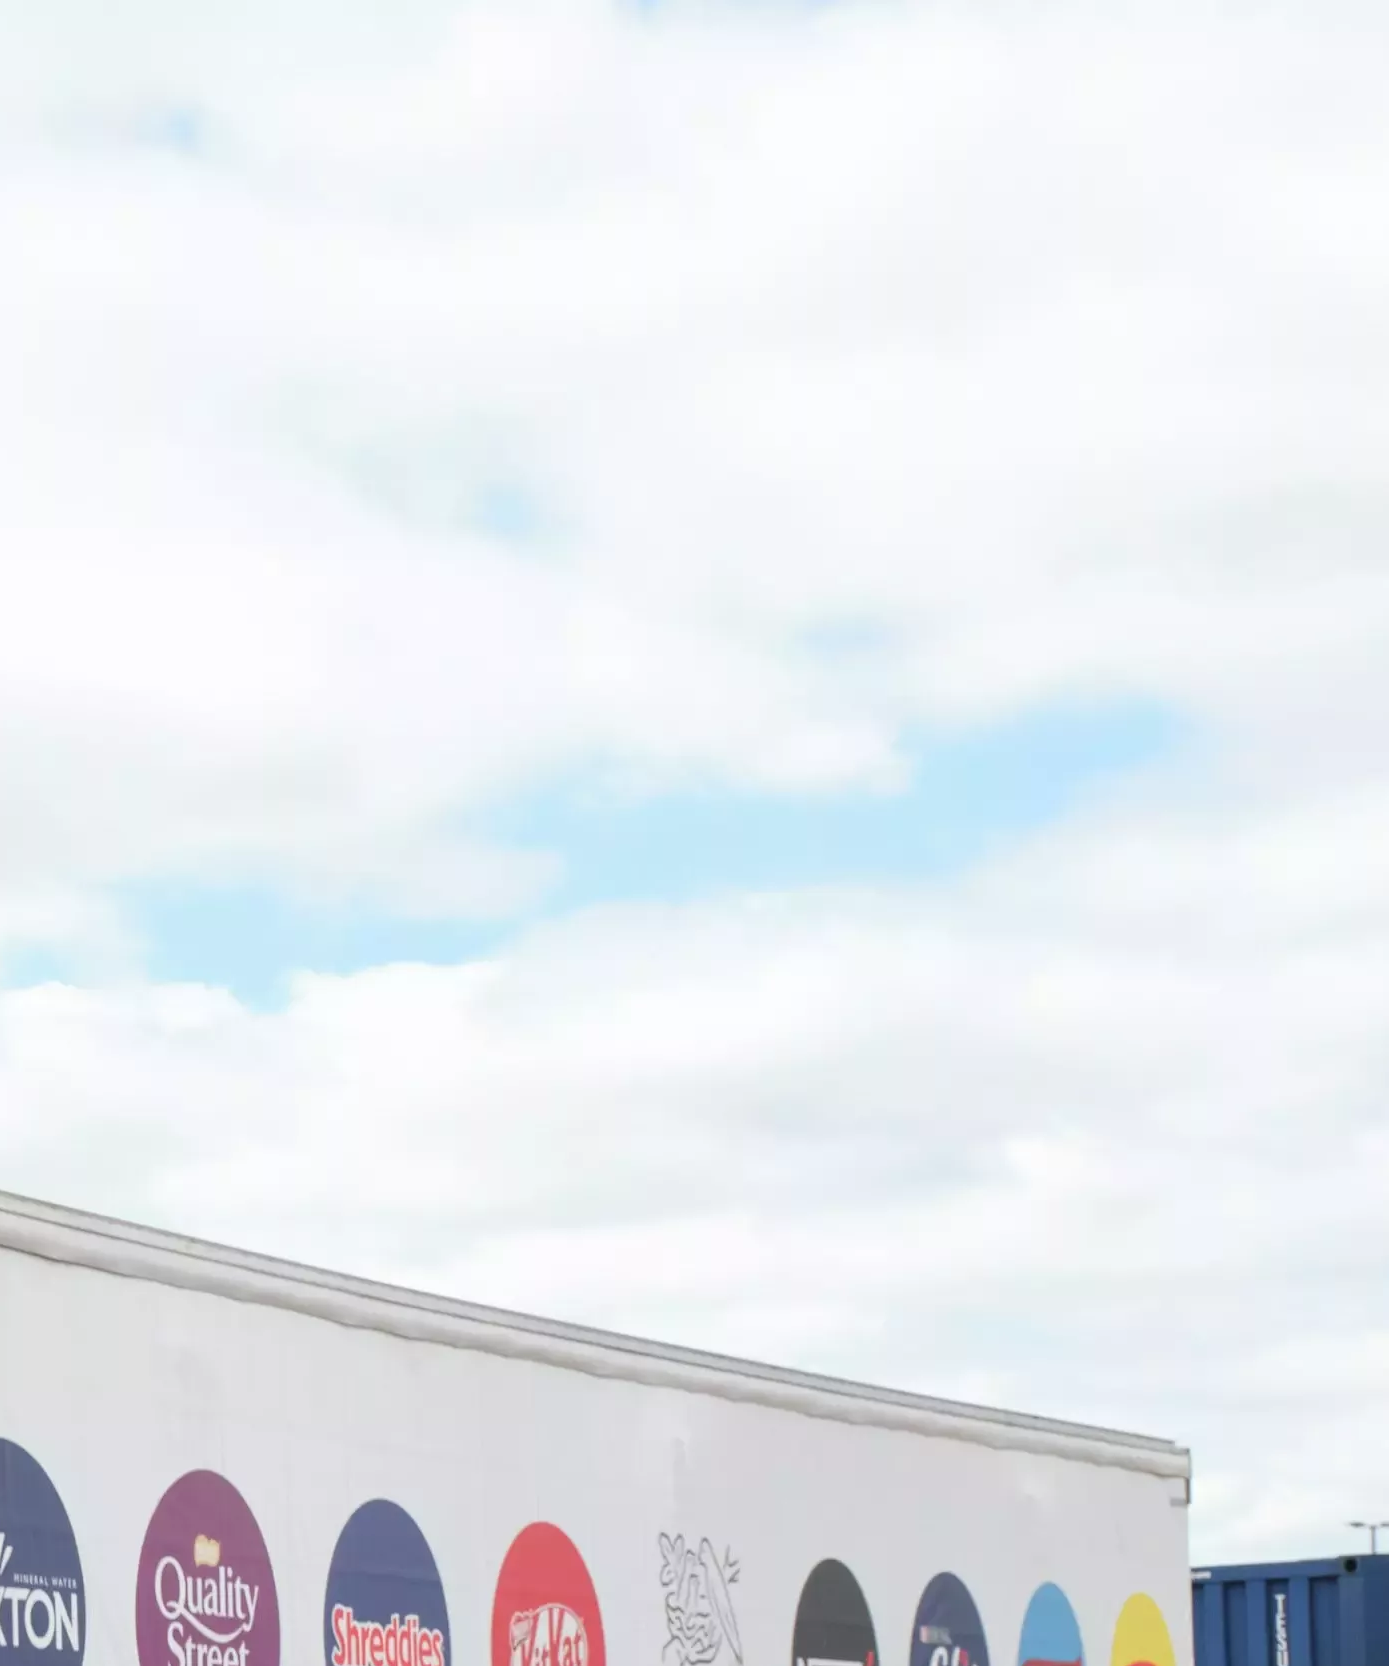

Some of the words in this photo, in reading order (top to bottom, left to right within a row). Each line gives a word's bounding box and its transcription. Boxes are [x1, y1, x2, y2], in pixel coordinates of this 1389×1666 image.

[13, 1572, 49, 1587] MINERAL
[51, 1576, 78, 1589] WATER
[154, 1555, 260, 1644] Quality
